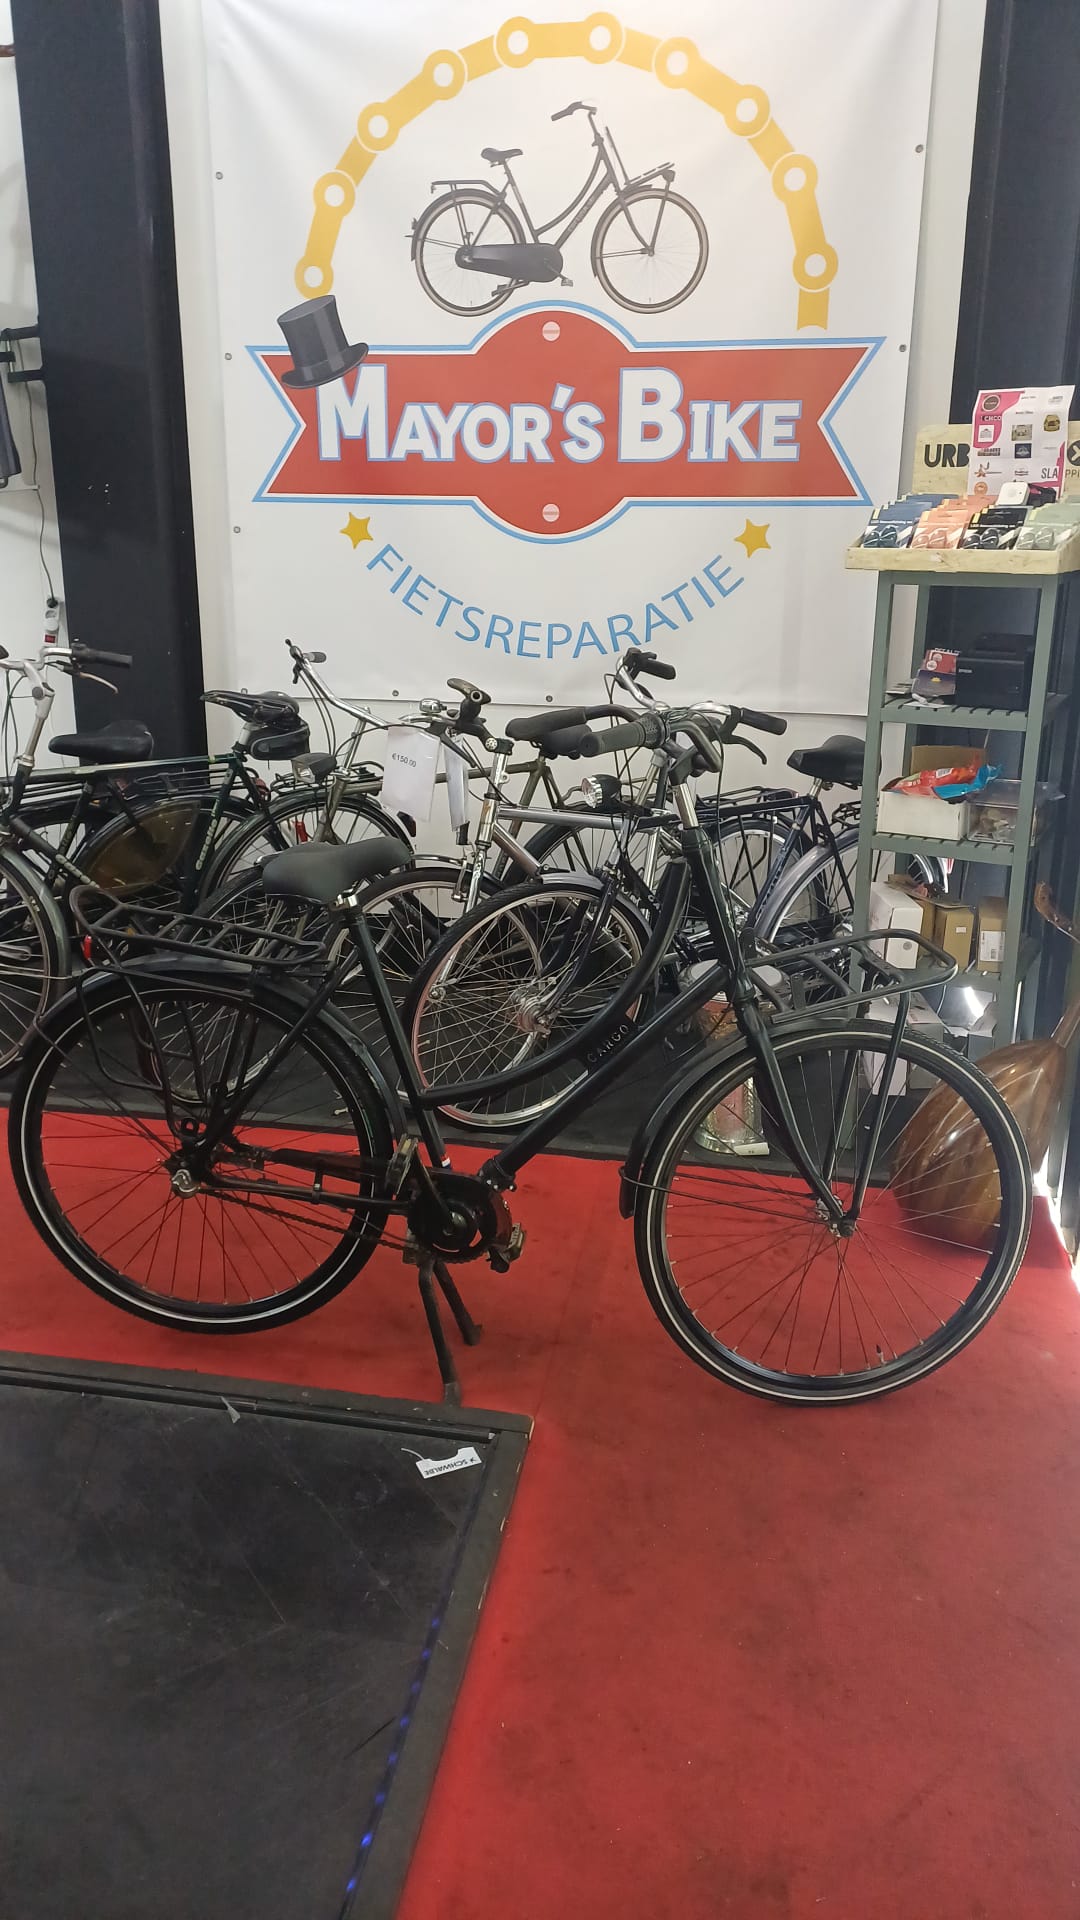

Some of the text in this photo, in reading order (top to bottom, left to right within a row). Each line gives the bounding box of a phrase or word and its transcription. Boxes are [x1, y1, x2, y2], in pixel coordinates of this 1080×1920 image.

[316, 363, 802, 463] MAYOR'S BIKE
[366, 543, 745, 660] FIETSREPARATIE
[392, 753, 416, 767] €150.00
